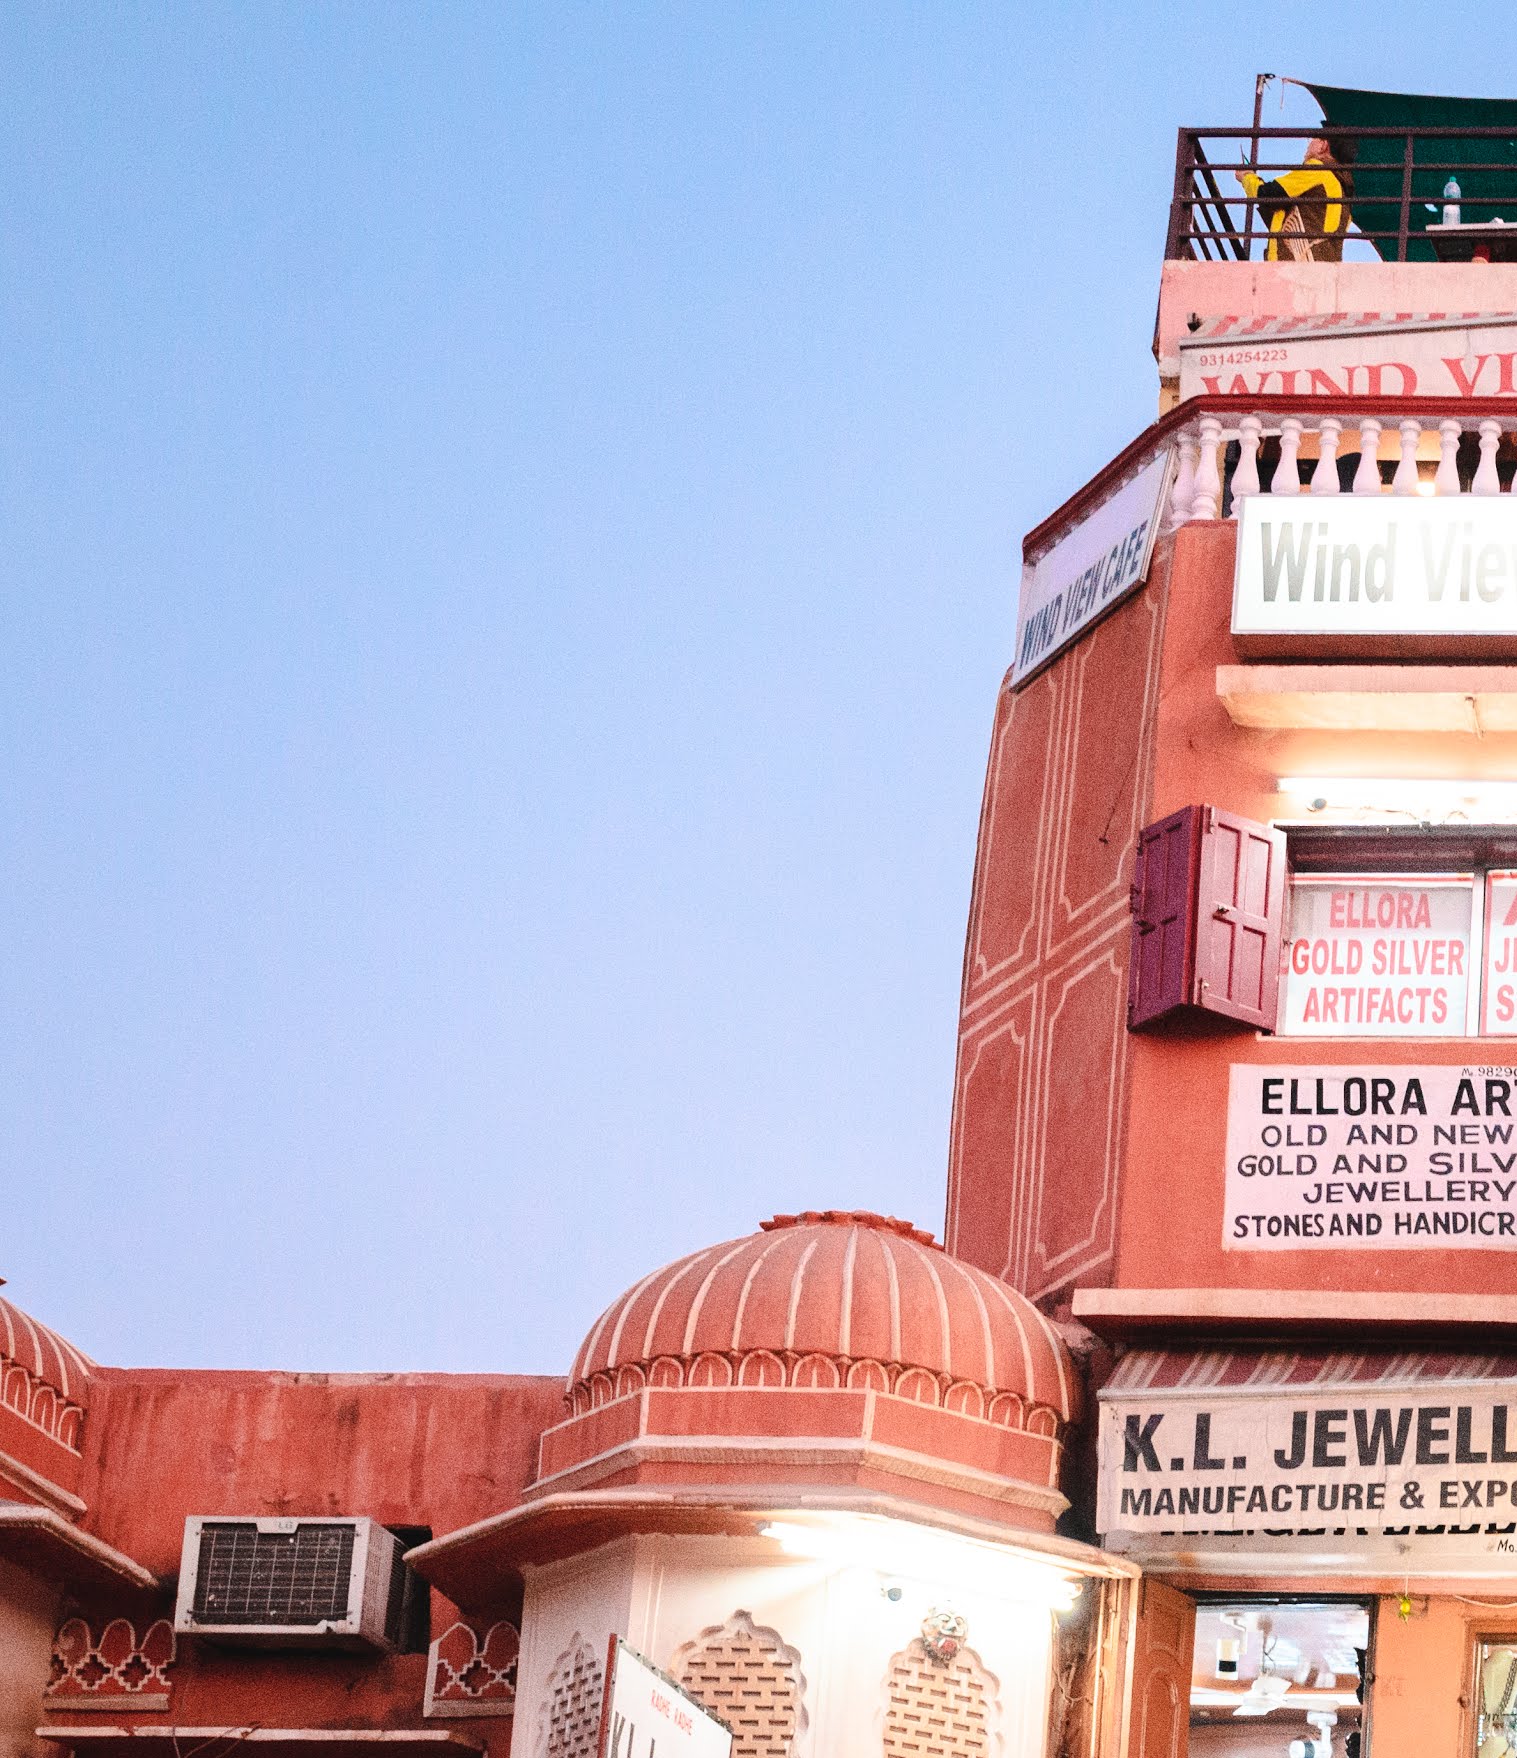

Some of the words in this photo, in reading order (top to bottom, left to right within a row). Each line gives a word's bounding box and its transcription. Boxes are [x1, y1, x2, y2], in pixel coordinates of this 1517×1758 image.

[1200, 350, 1288, 367] 9314254223
[1260, 521, 1394, 604] Wind
[1020, 594, 1062, 669] WIND
[1063, 556, 1106, 633] VIEW
[1102, 520, 1148, 599] CAFE
[1329, 893, 1431, 929] ELLORA
[1293, 938, 1363, 976] GOLD
[1372, 938, 1464, 976] SILVER
[1303, 988, 1447, 1024] ARTIFACTS
[1261, 1078, 1427, 1115] ELLORA
[1261, 1125, 1327, 1147] OLD
[1347, 1124, 1417, 1145] AND
[1434, 1124, 1513, 1145] NEW
[1238, 1156, 1317, 1177] GOLD
[1332, 1154, 1408, 1174] AND
[1303, 1181, 1517, 1204] JEWELLERY
[1234, 1213, 1324, 1238] STONES
[1329, 1213, 1381, 1236] AND
[1123, 1413, 1247, 1472] K.L.
[1120, 1483, 1386, 1515] MANUFACTURE
